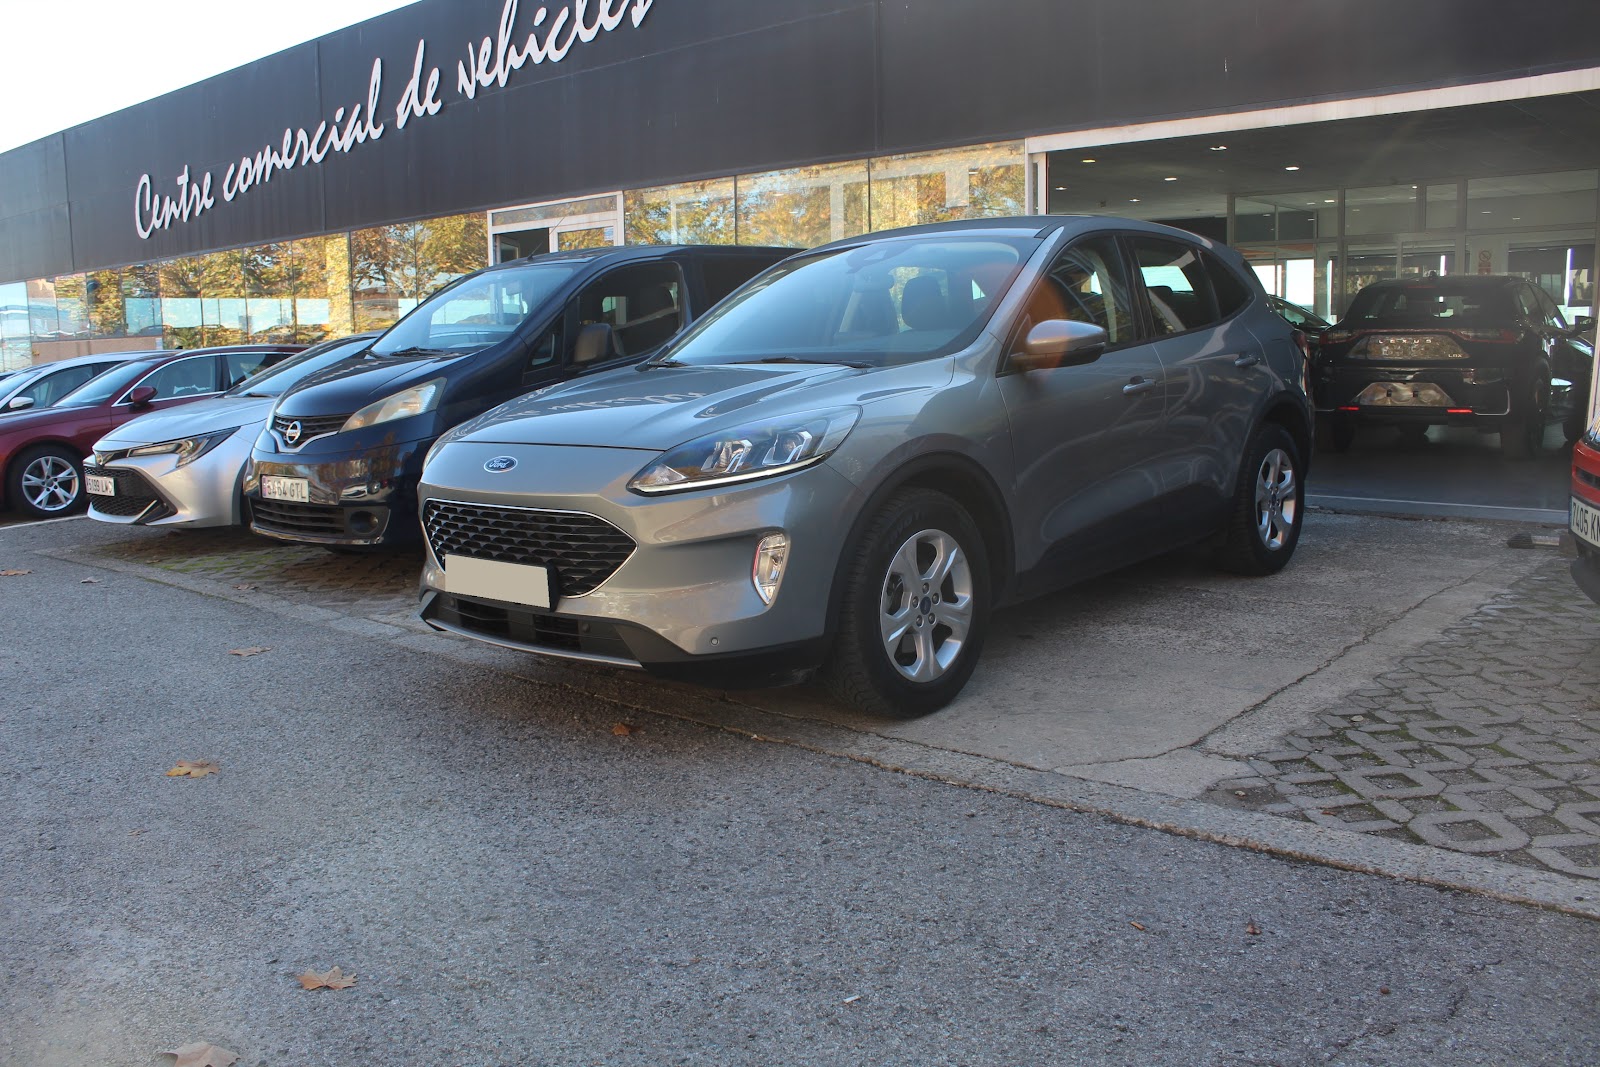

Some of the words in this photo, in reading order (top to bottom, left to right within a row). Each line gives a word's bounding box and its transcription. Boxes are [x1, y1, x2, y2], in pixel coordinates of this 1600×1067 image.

[135, 165, 214, 239] Centre
[223, 58, 384, 201] comercial
[396, 39, 443, 129] de
[486, 457, 512, 470] Ford
[290, 482, 306, 499] GTL
[1573, 502, 1588, 535] 7405
